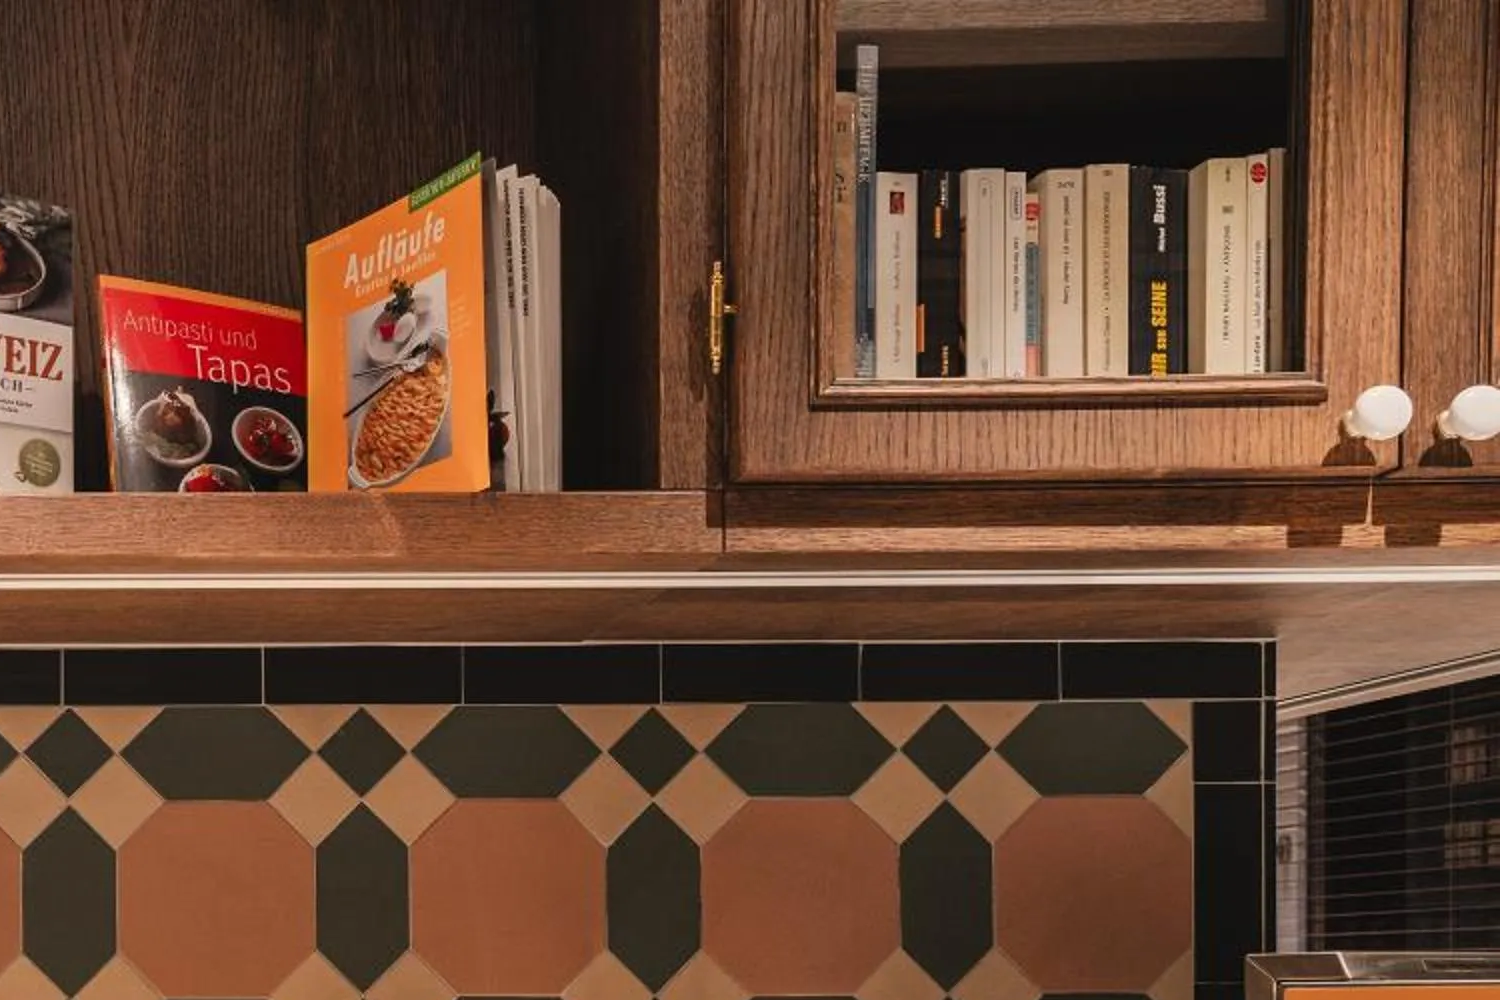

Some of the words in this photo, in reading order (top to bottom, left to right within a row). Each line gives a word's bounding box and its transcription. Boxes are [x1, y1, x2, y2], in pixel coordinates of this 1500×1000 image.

[1153, 184, 1167, 224] Bussi
[1152, 281, 1167, 327] SEINE
[123, 309, 213, 343] Antipasti
[219, 326, 258, 350] und
[187, 342, 292, 395] Tapas
